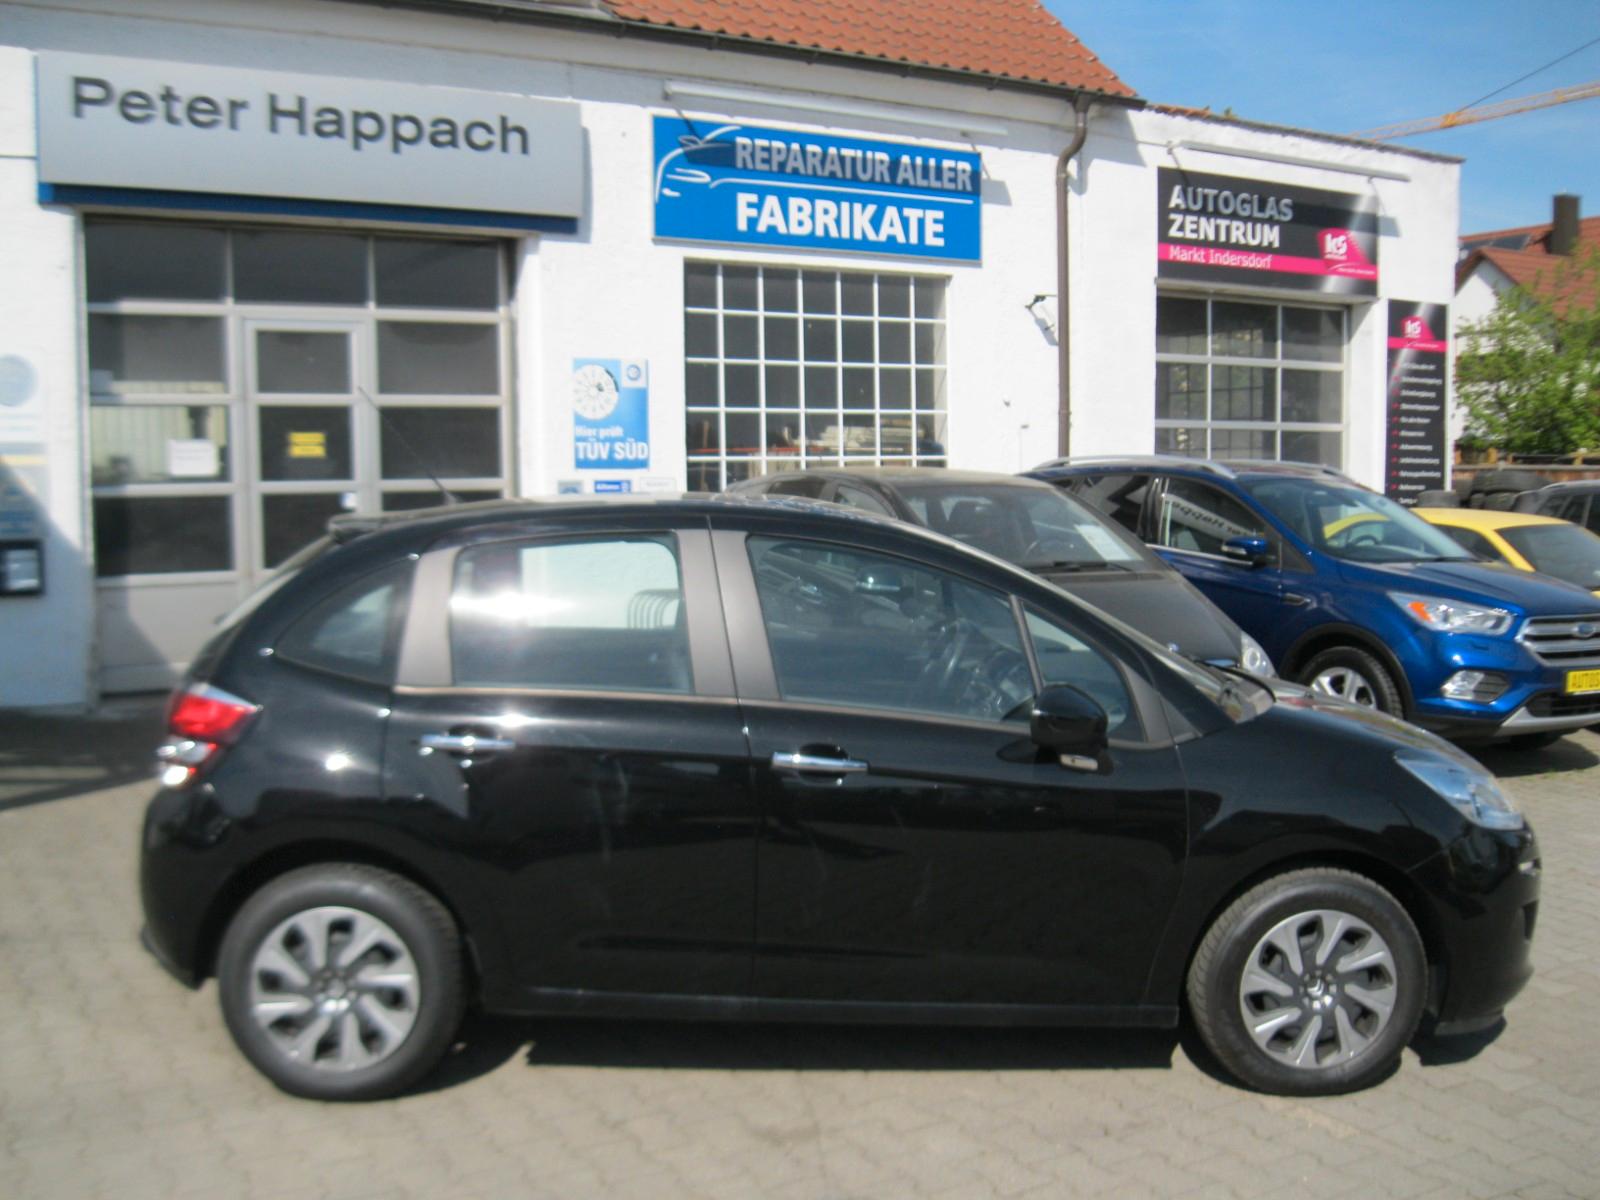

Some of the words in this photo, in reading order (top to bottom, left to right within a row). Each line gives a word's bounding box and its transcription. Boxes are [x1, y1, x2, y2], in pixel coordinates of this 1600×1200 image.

[71, 75, 250, 132] Peter
[268, 93, 530, 155] Happach
[735, 137, 889, 183] REPARATUR
[896, 154, 973, 192] ALLER
[736, 192, 945, 247] FABRIKATE
[1168, 185, 1293, 222] AUTOGLAS
[1168, 213, 1281, 248] ZENTRUM
[1169, 246, 1206, 263] Markt
[1208, 250, 1273, 269] Indersdorf
[575, 437, 610, 460] TÜV
[614, 437, 649, 460] SÜD
